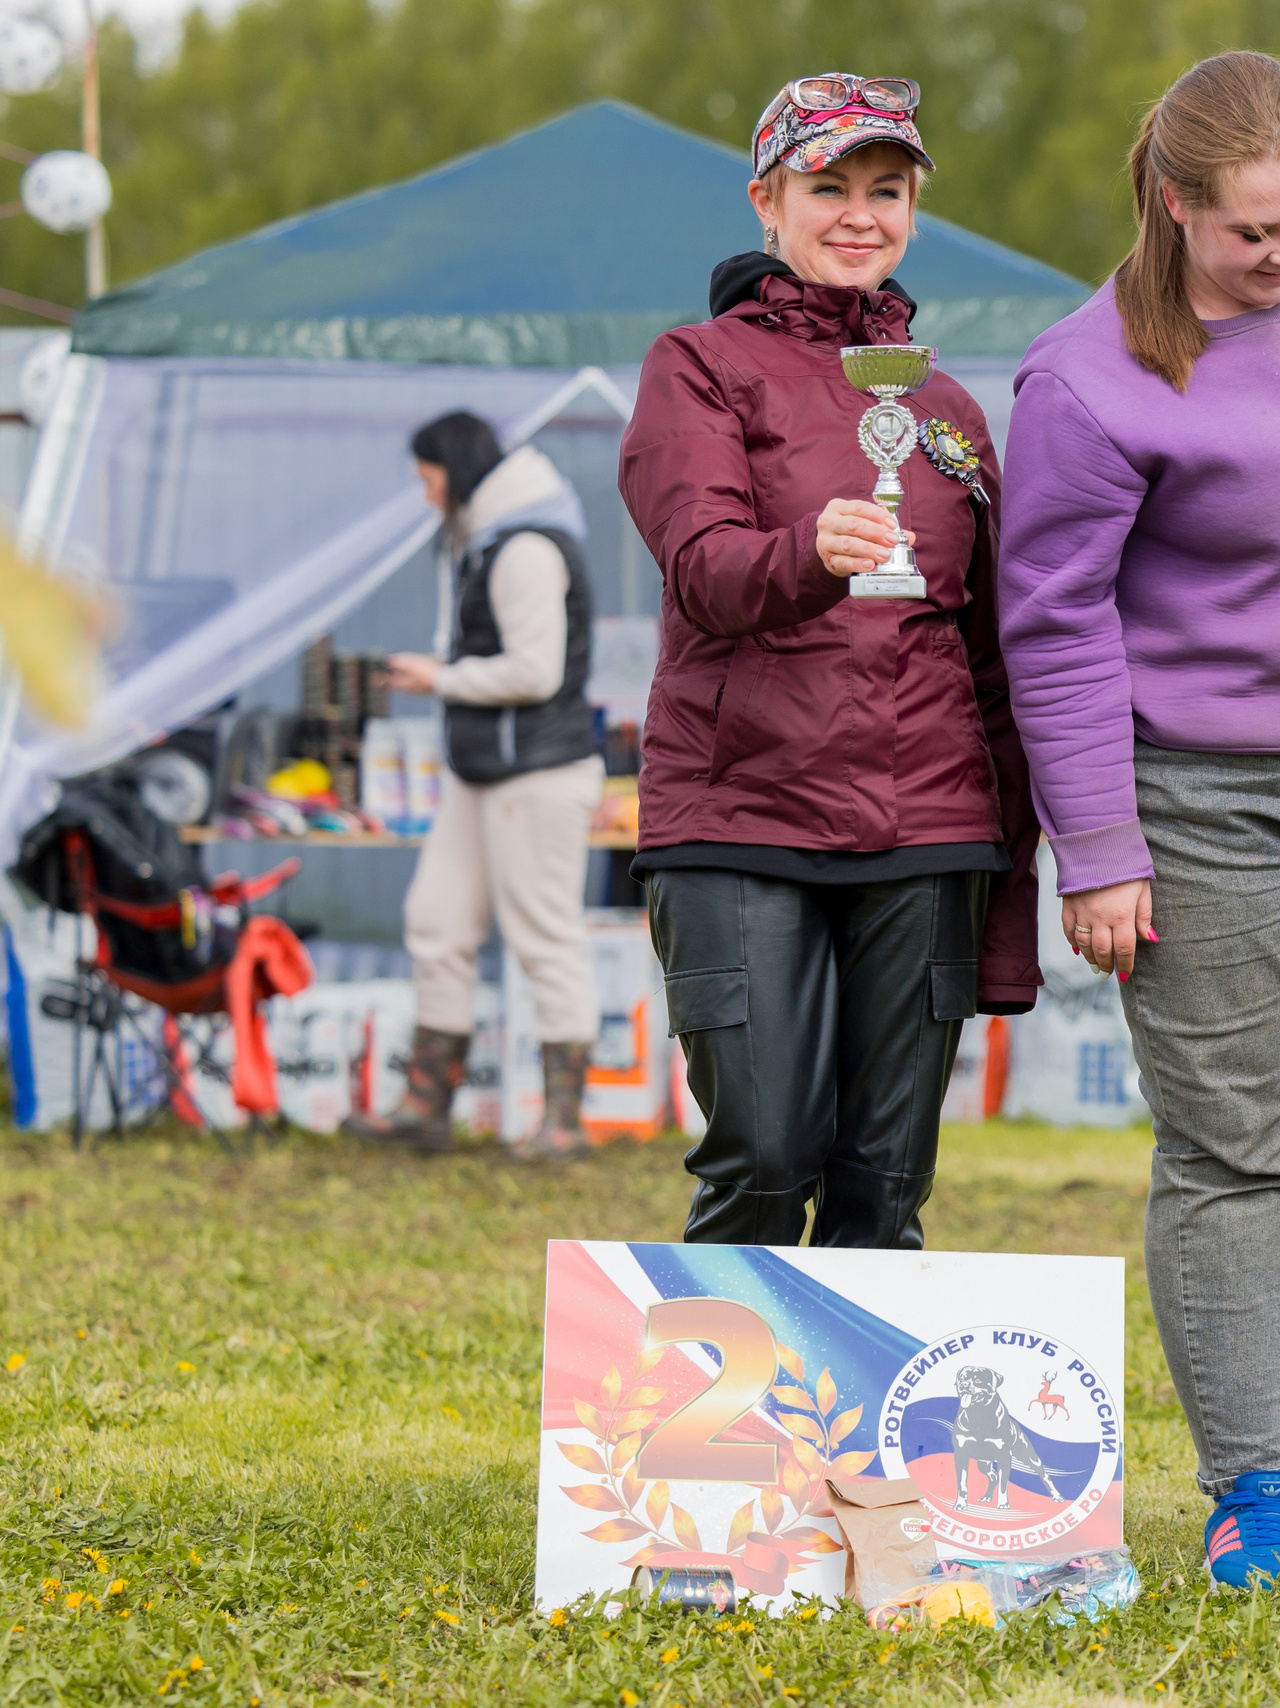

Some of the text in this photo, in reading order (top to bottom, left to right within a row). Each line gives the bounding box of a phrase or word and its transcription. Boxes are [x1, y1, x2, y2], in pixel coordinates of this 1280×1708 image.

[636, 1297, 779, 1482] 2
[885, 1331, 1117, 1453] РОТВЕЙЛЕР КЛУБ РОССИИ
[920, 1488, 1103, 1550] ЖЕГОРОДСКОЕ РО
